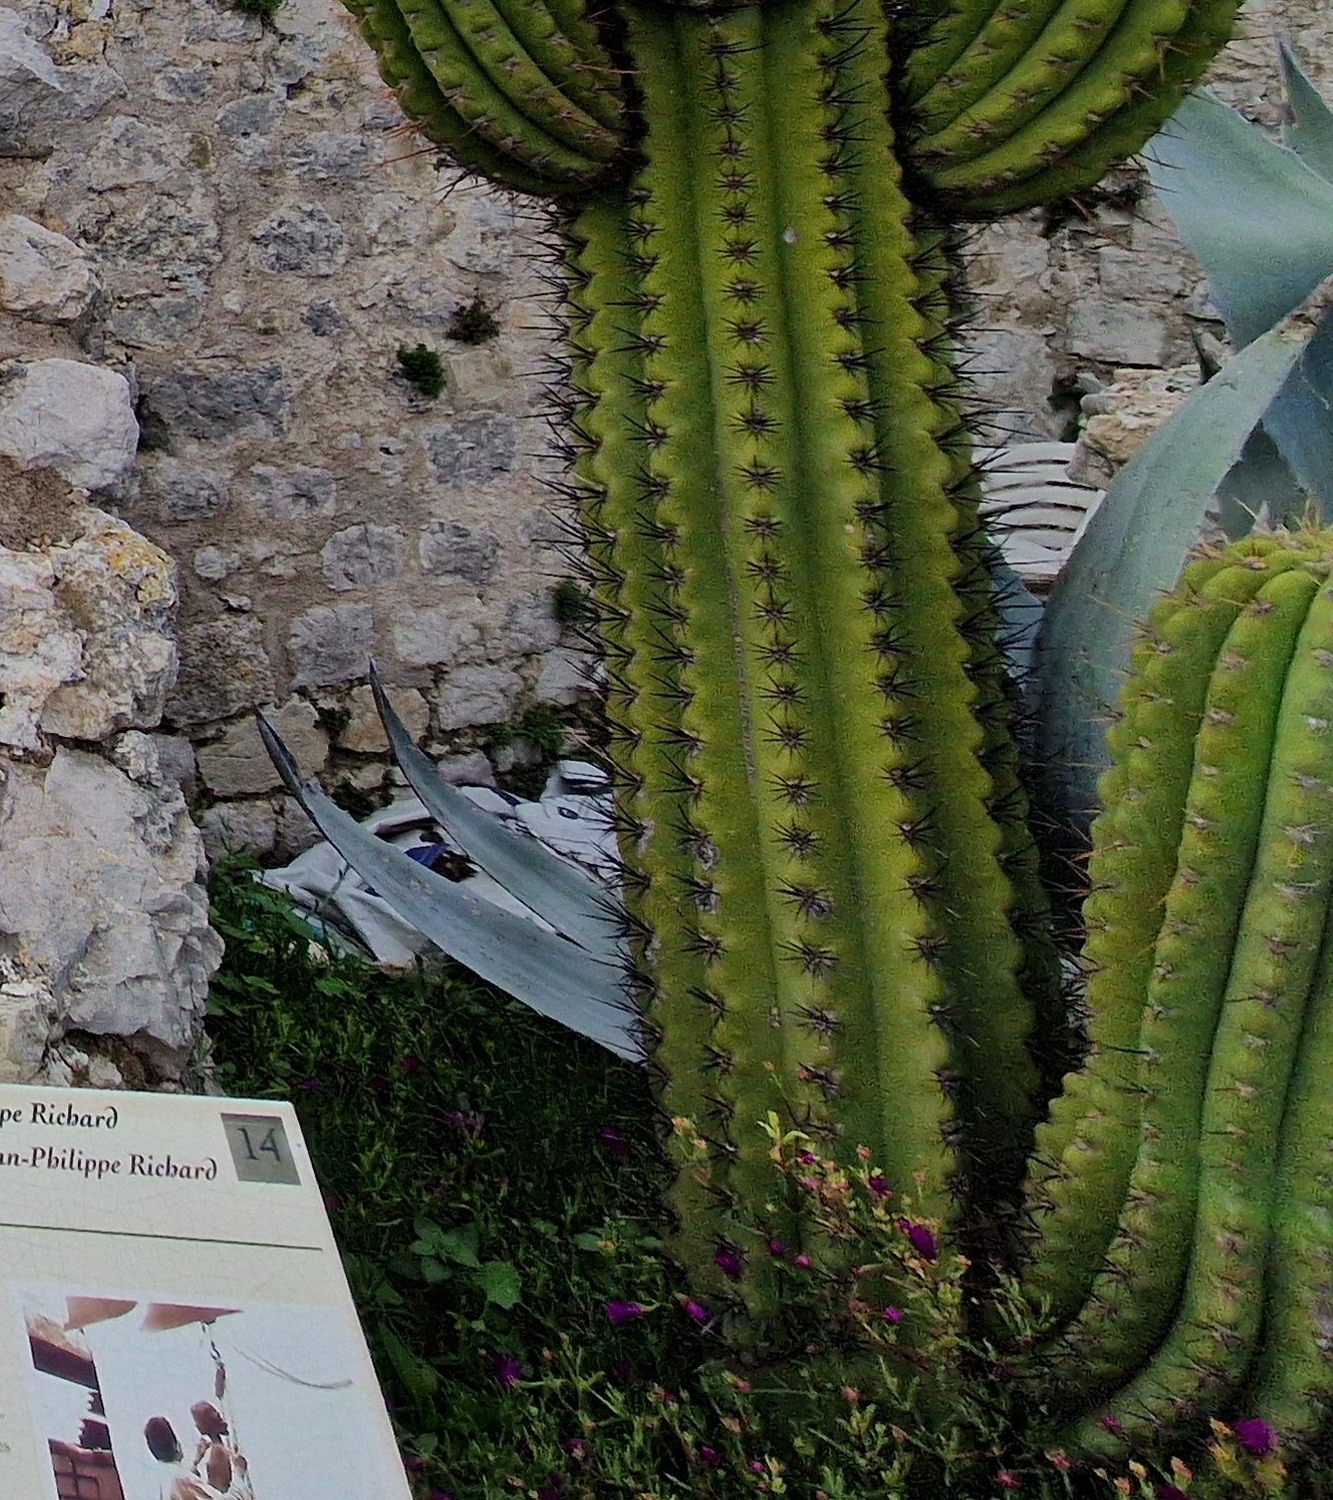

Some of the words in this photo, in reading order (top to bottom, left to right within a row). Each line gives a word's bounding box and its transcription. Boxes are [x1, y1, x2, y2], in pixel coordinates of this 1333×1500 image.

[31, 1101, 119, 1130] Richard
[238, 1127, 283, 1163] 14
[129, 1153, 218, 1181] Richard
